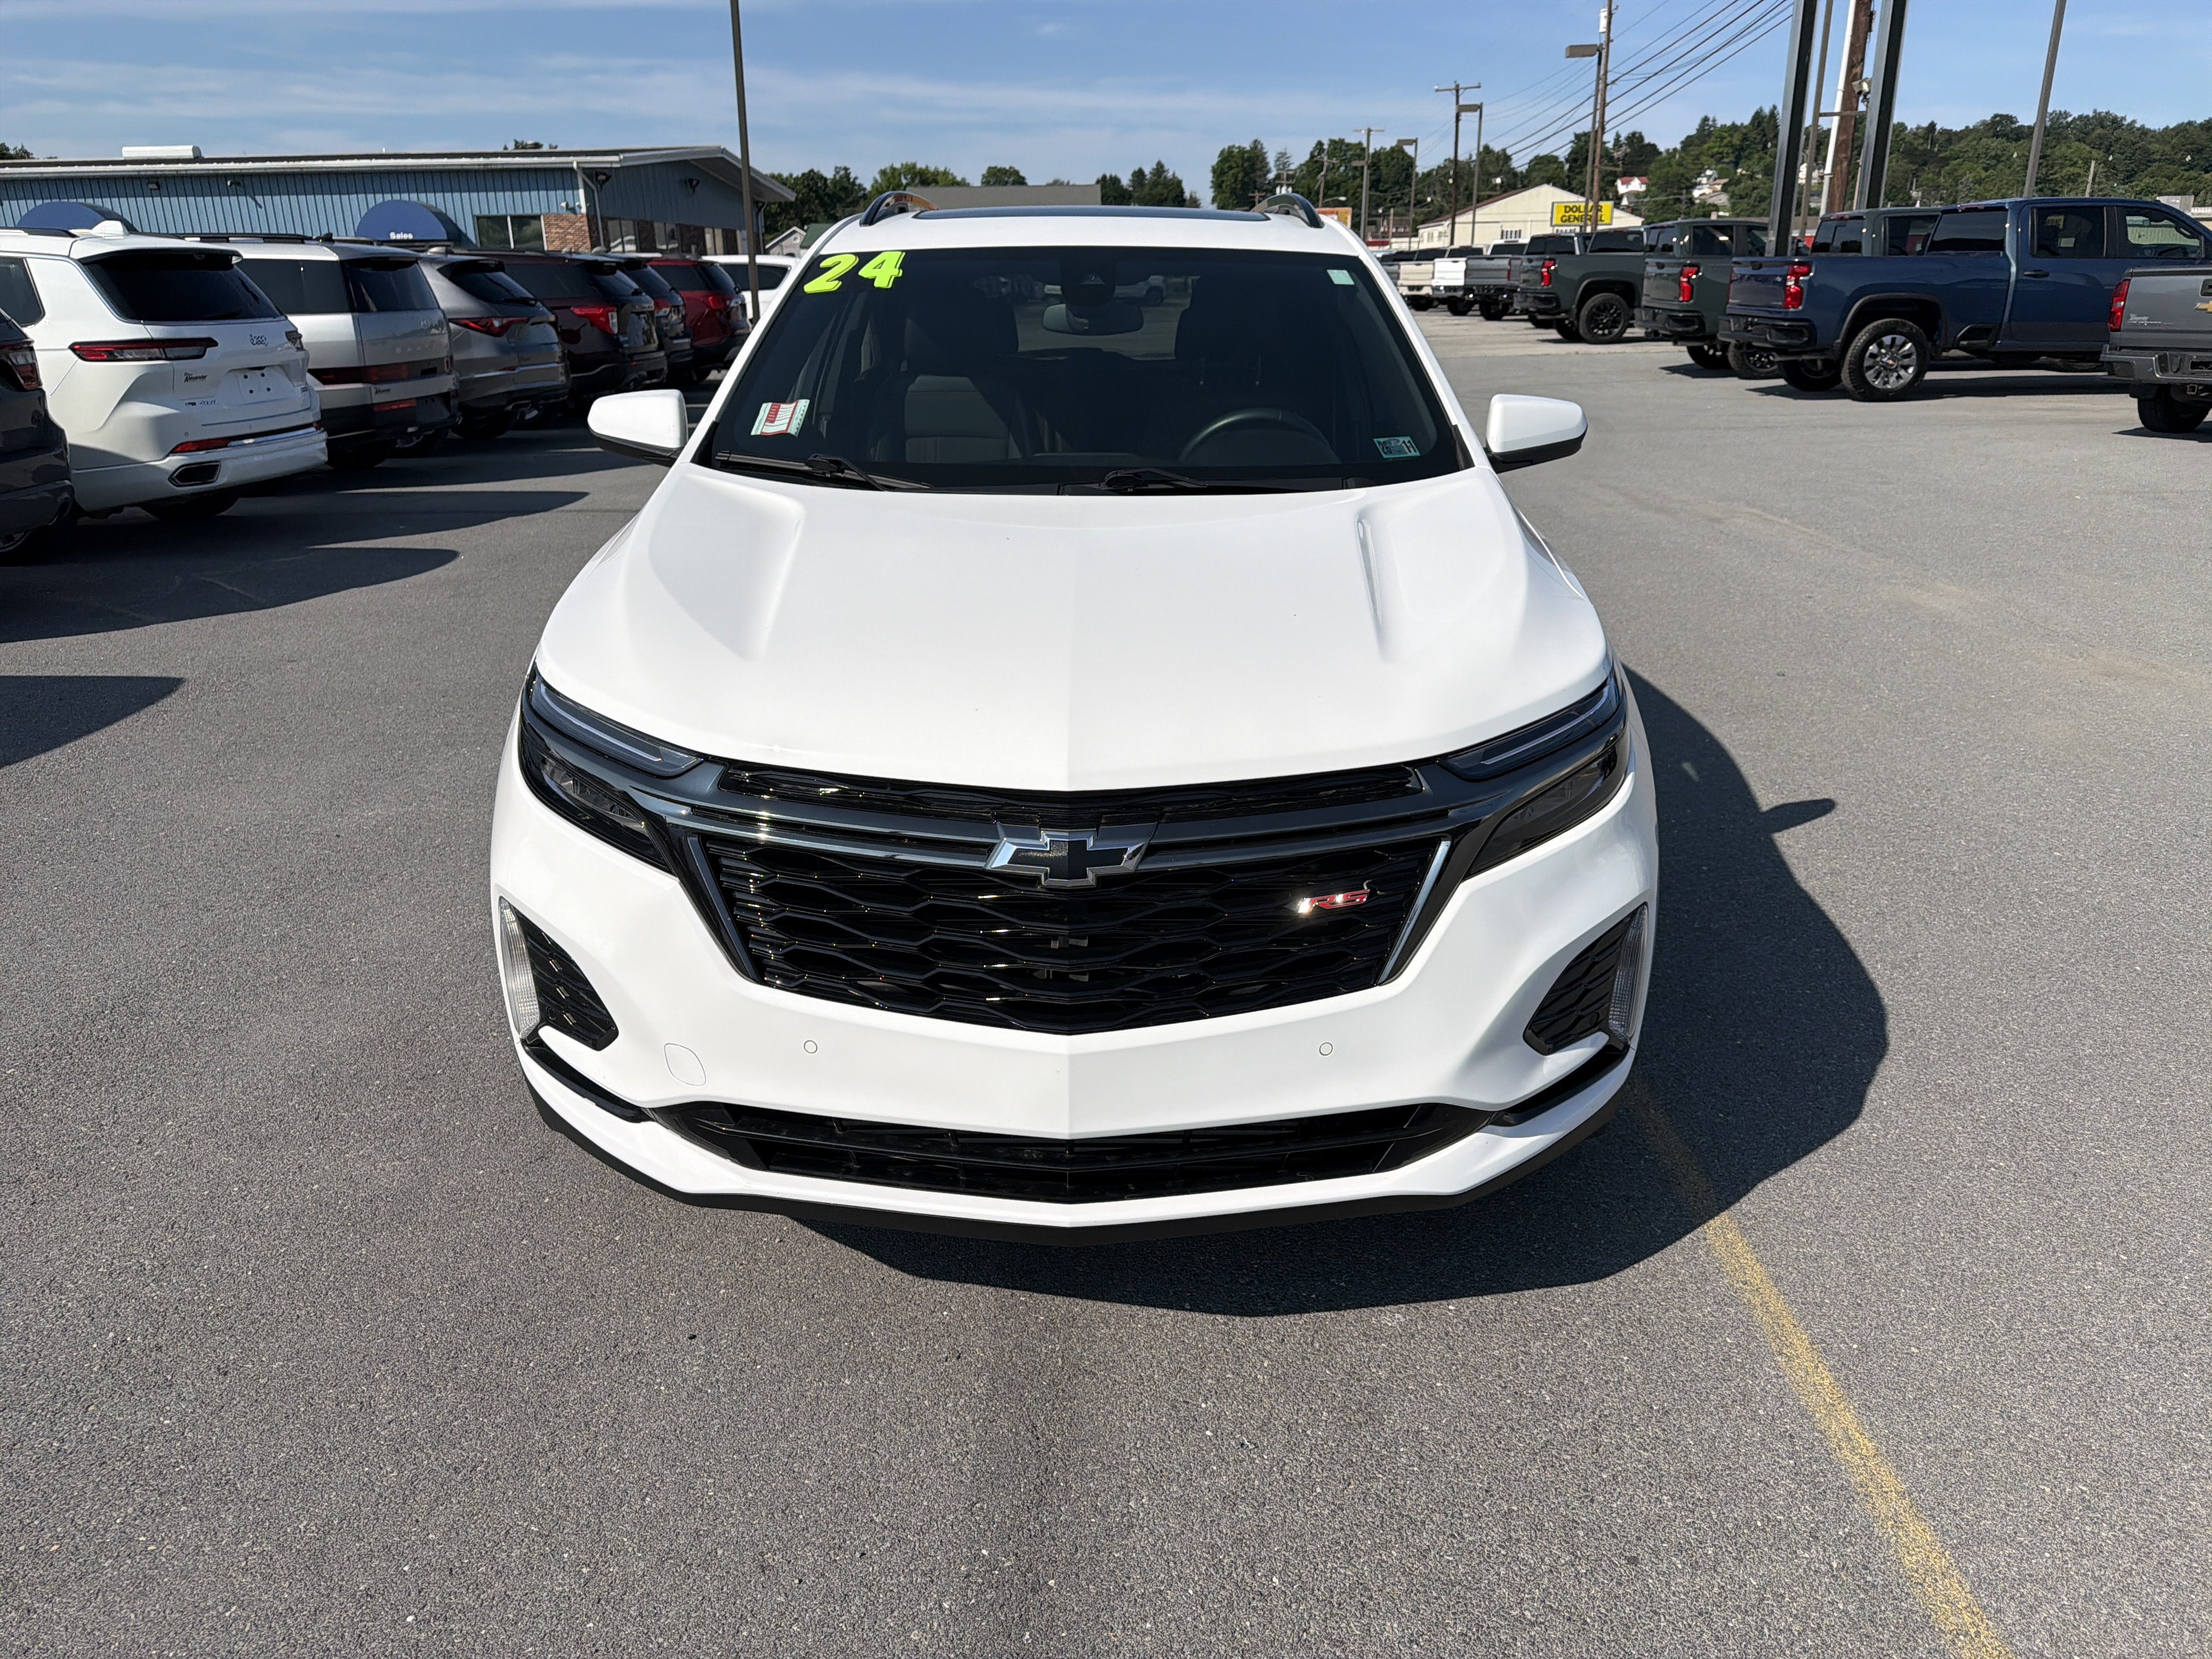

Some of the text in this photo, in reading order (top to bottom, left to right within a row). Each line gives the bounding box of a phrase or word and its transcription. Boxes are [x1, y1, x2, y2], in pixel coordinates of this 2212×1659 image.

[1564, 205, 1603, 213] DOLR
[1560, 214, 1605, 223] GENERL
[390, 232, 413, 240] Sales
[804, 251, 906, 294] 24
[1298, 889, 1370, 913] RS
